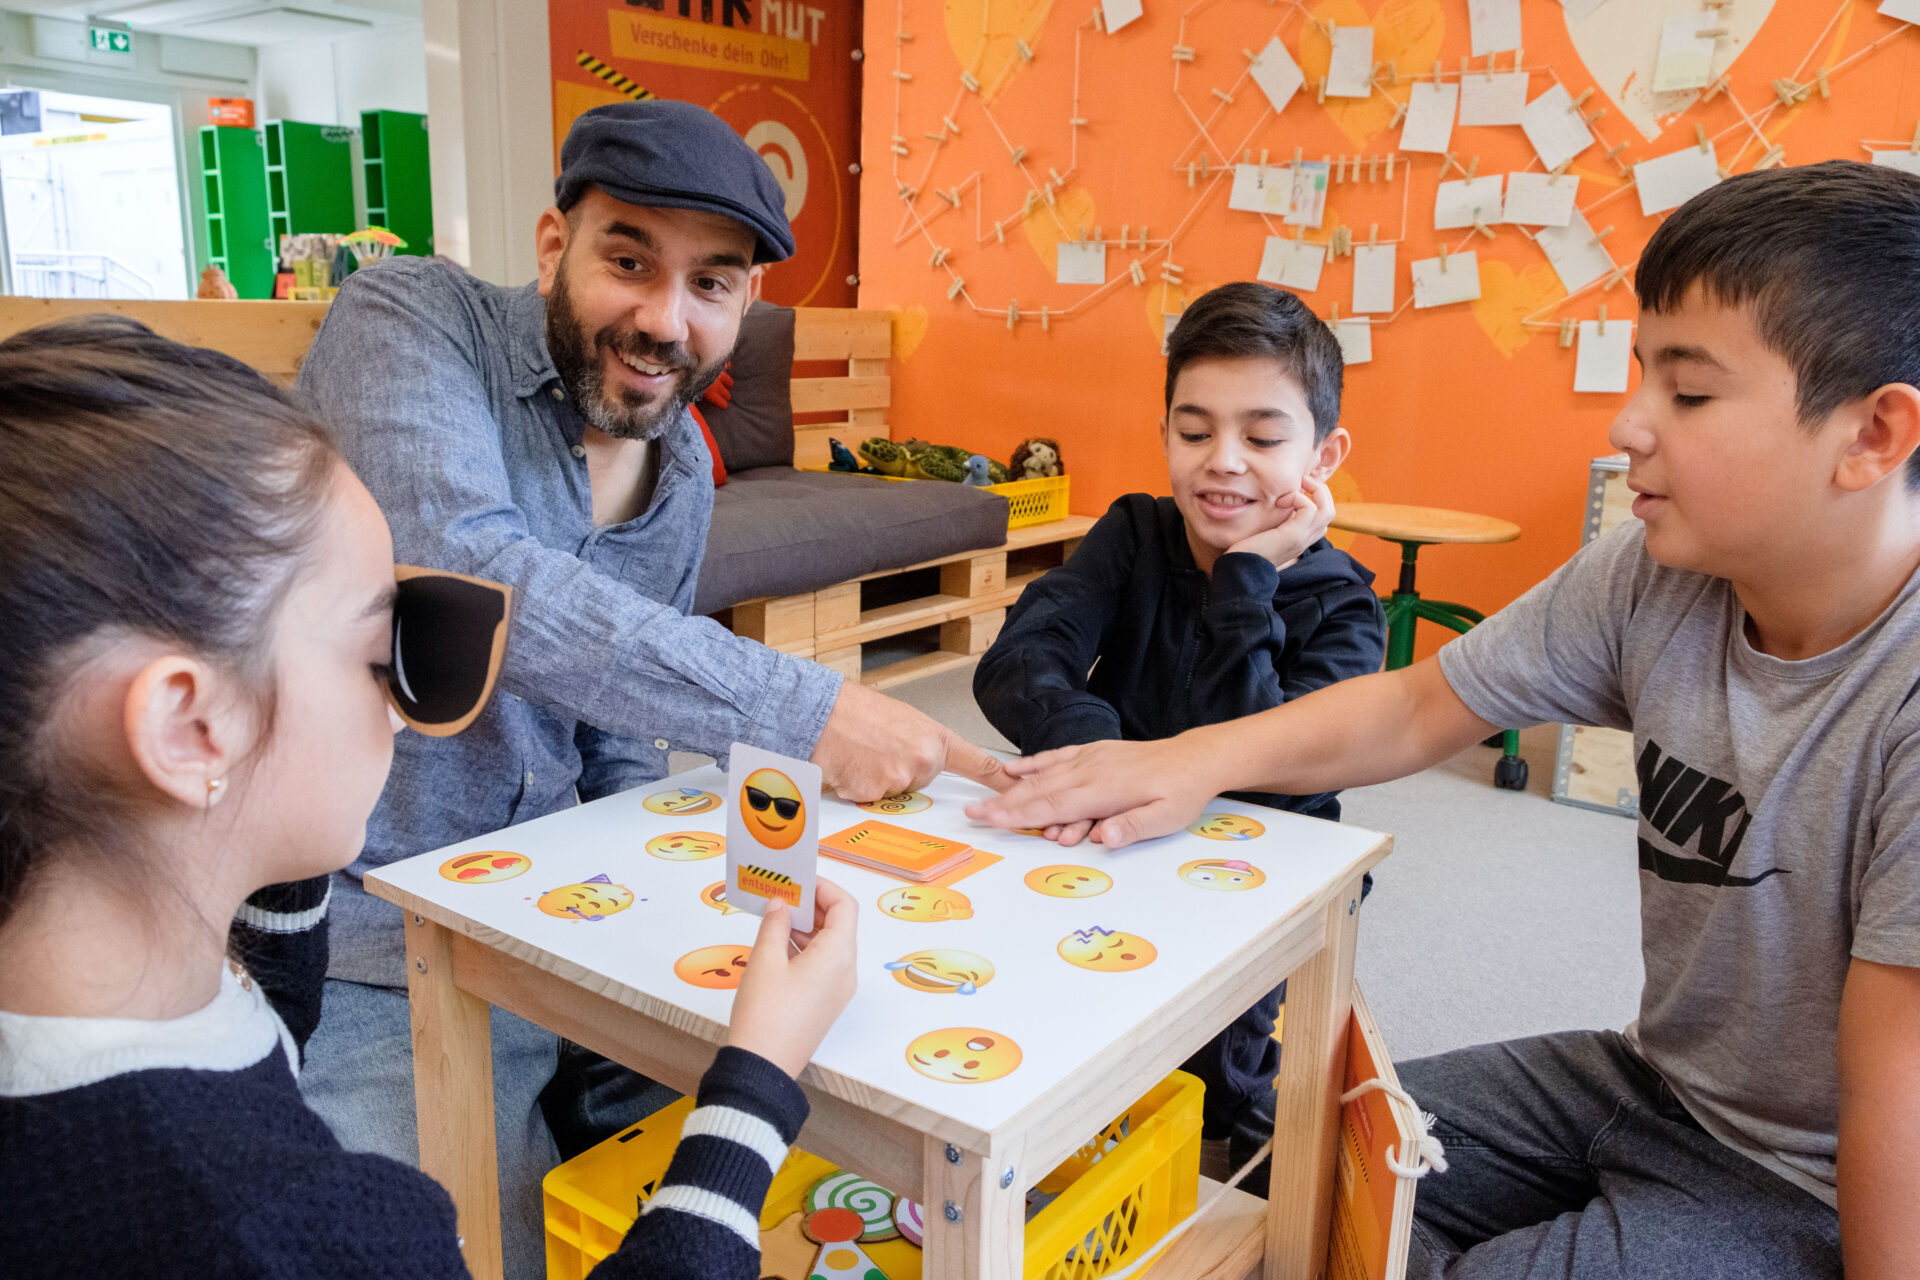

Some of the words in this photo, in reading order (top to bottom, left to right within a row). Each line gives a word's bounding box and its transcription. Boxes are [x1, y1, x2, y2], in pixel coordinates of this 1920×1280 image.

[761, 0, 825, 45] MUT
[630, 21, 718, 58] Verschenke
[723, 42, 754, 65] dein
[760, 49, 789, 71] Ohr!
[742, 876, 796, 901] entspannt
